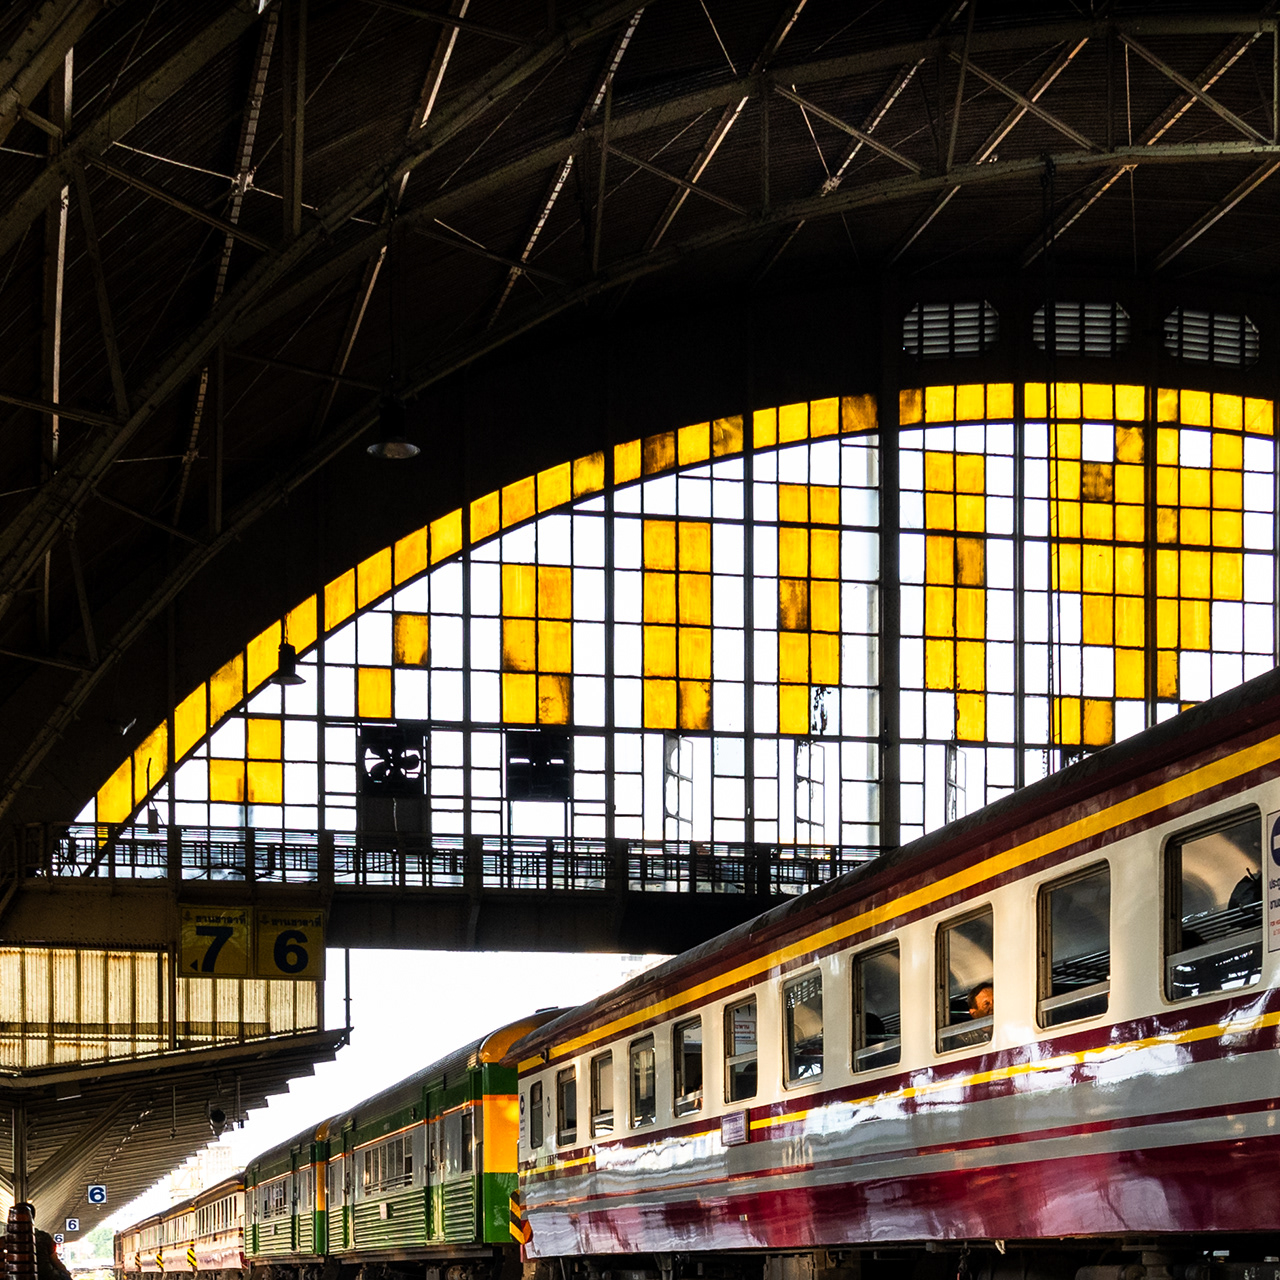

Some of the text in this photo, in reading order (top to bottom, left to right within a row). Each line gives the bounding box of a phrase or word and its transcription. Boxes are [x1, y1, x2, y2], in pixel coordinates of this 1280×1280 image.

[196, 926, 233, 973] 7
[273, 929, 309, 974] 6
[89, 1186, 105, 1203] 6
[68, 1219, 77, 1230] 6
[54, 1234, 63, 1243] 6
